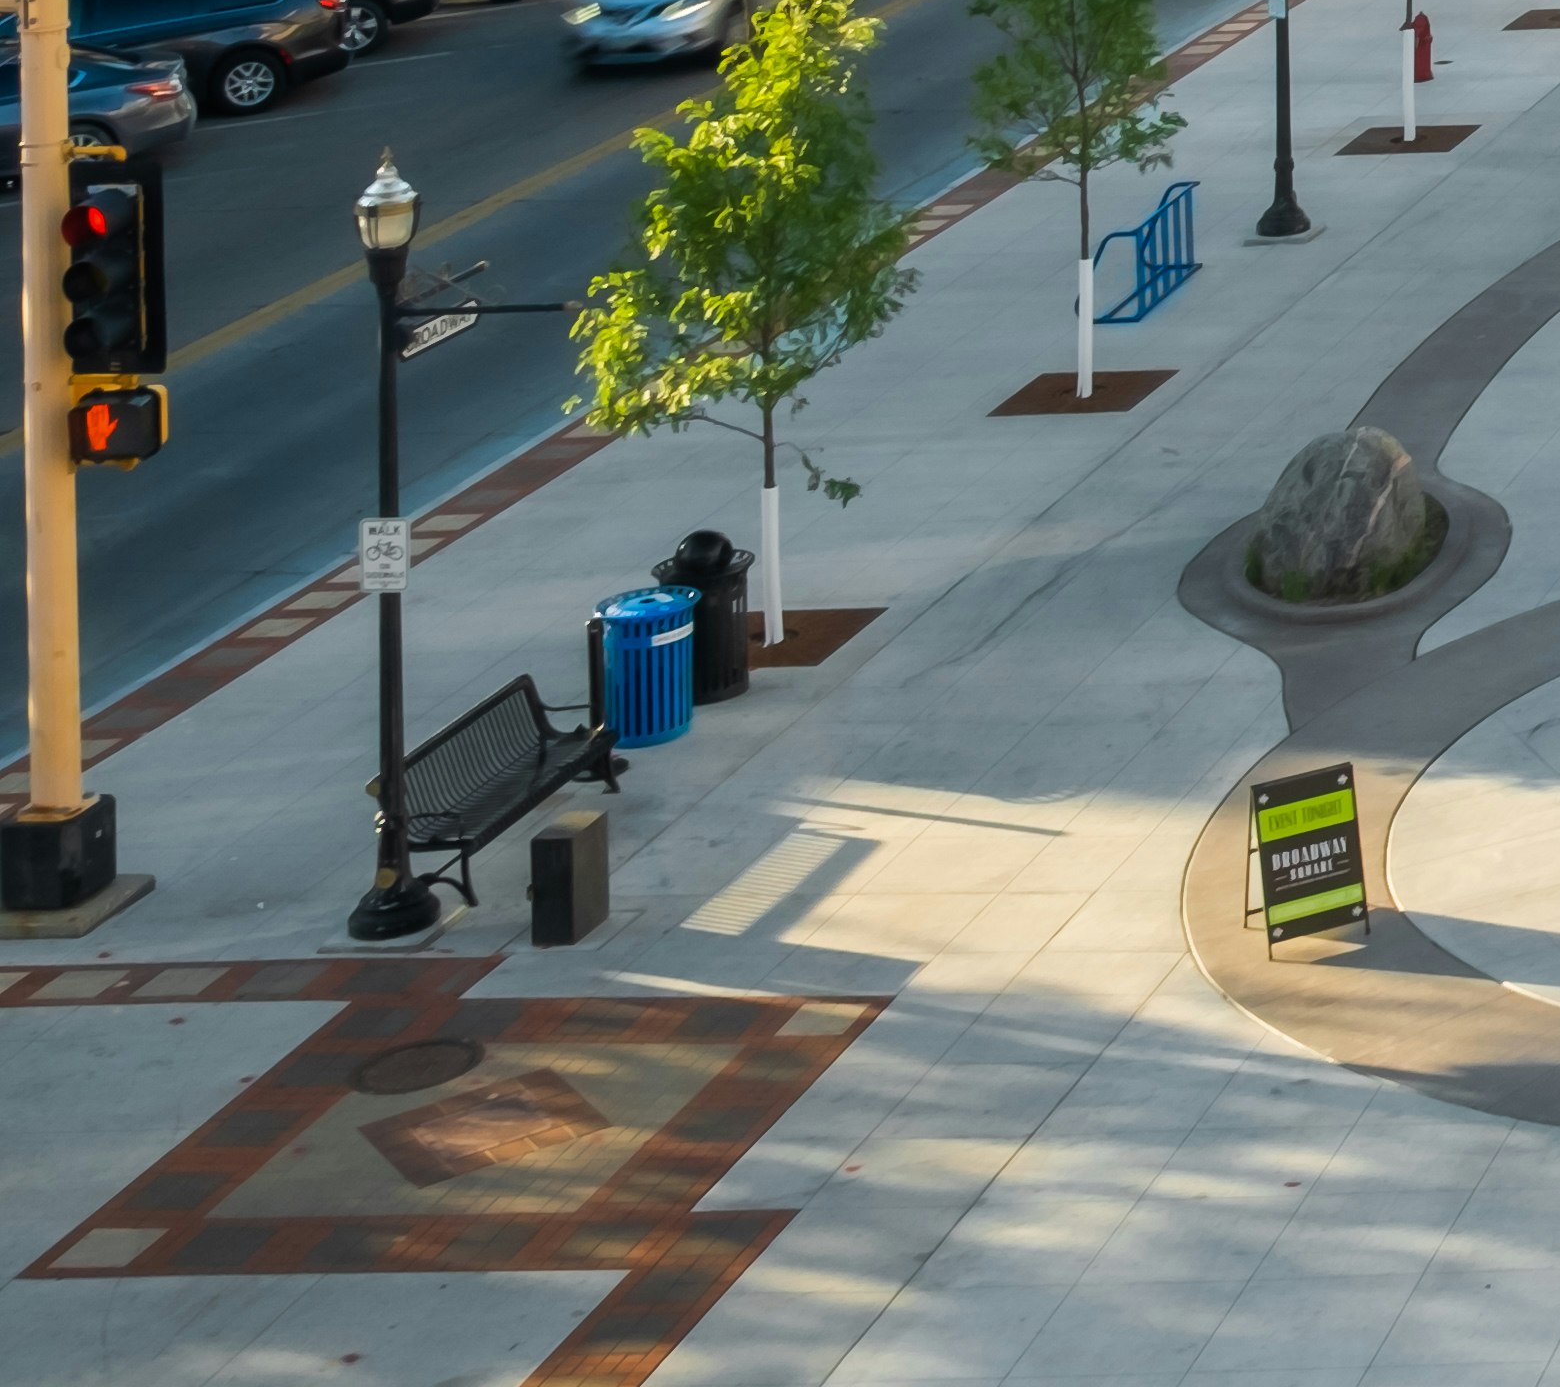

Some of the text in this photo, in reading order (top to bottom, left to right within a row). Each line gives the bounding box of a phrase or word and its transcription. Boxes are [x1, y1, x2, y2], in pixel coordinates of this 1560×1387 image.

[1268, 809, 1297, 832] EVENT
[1271, 836, 1348, 872] BROADWAY
[1289, 858, 1334, 881] SQUARE
